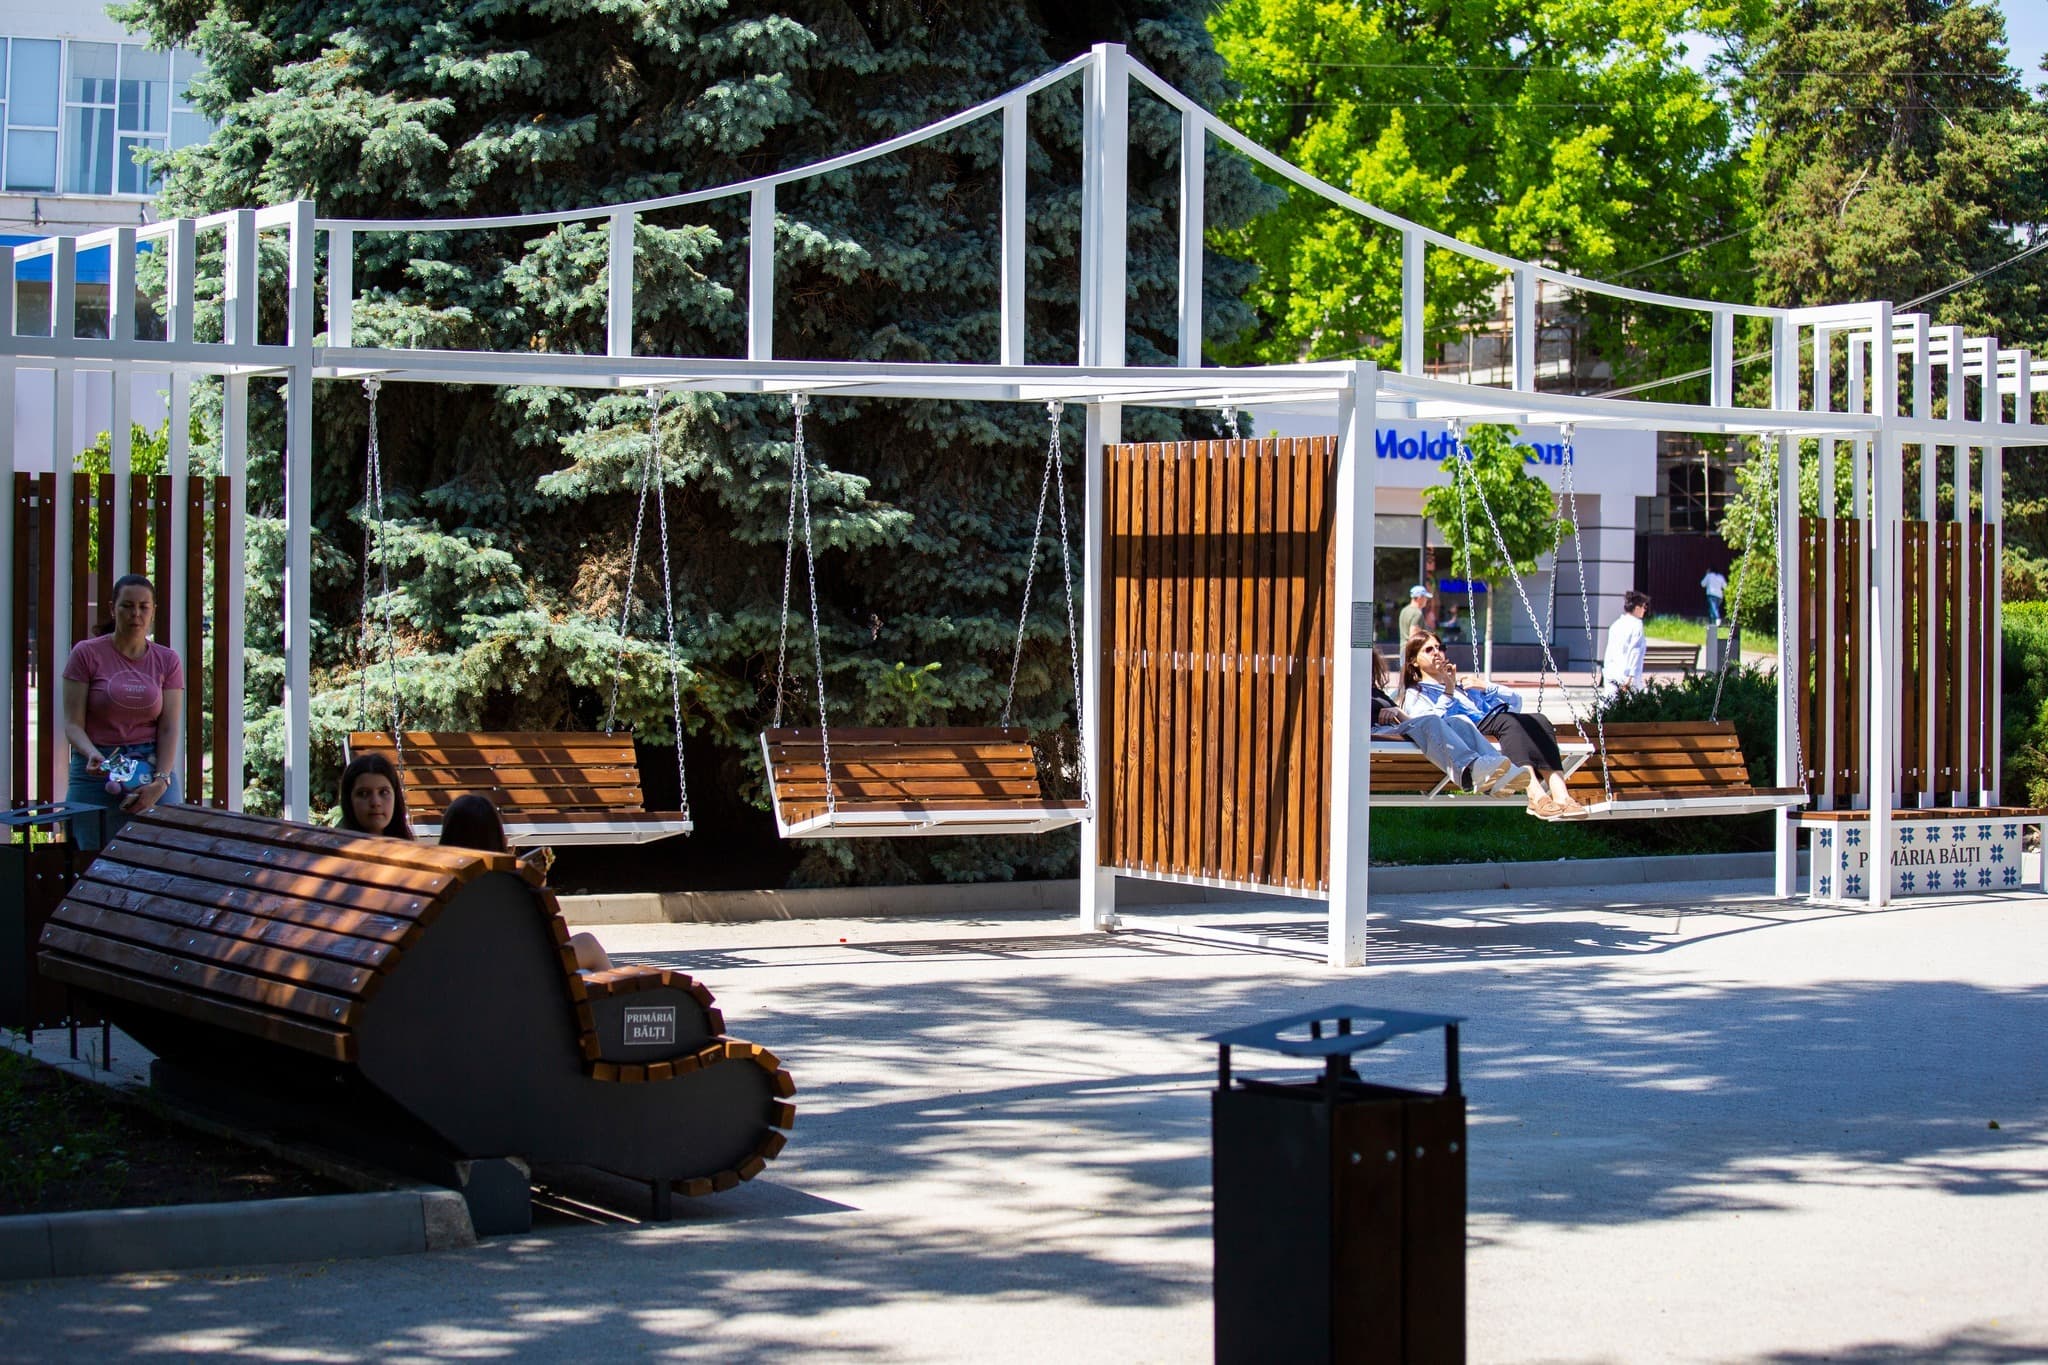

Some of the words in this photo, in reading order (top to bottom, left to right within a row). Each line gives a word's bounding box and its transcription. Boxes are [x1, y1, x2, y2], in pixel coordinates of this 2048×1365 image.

[1859, 845, 1935, 868] PMĂRIA
[1939, 844, 1981, 867] BĂLȚI
[626, 1012, 673, 1024] PRIMĂRIA
[633, 1025, 665, 1040] BĂLȚI
